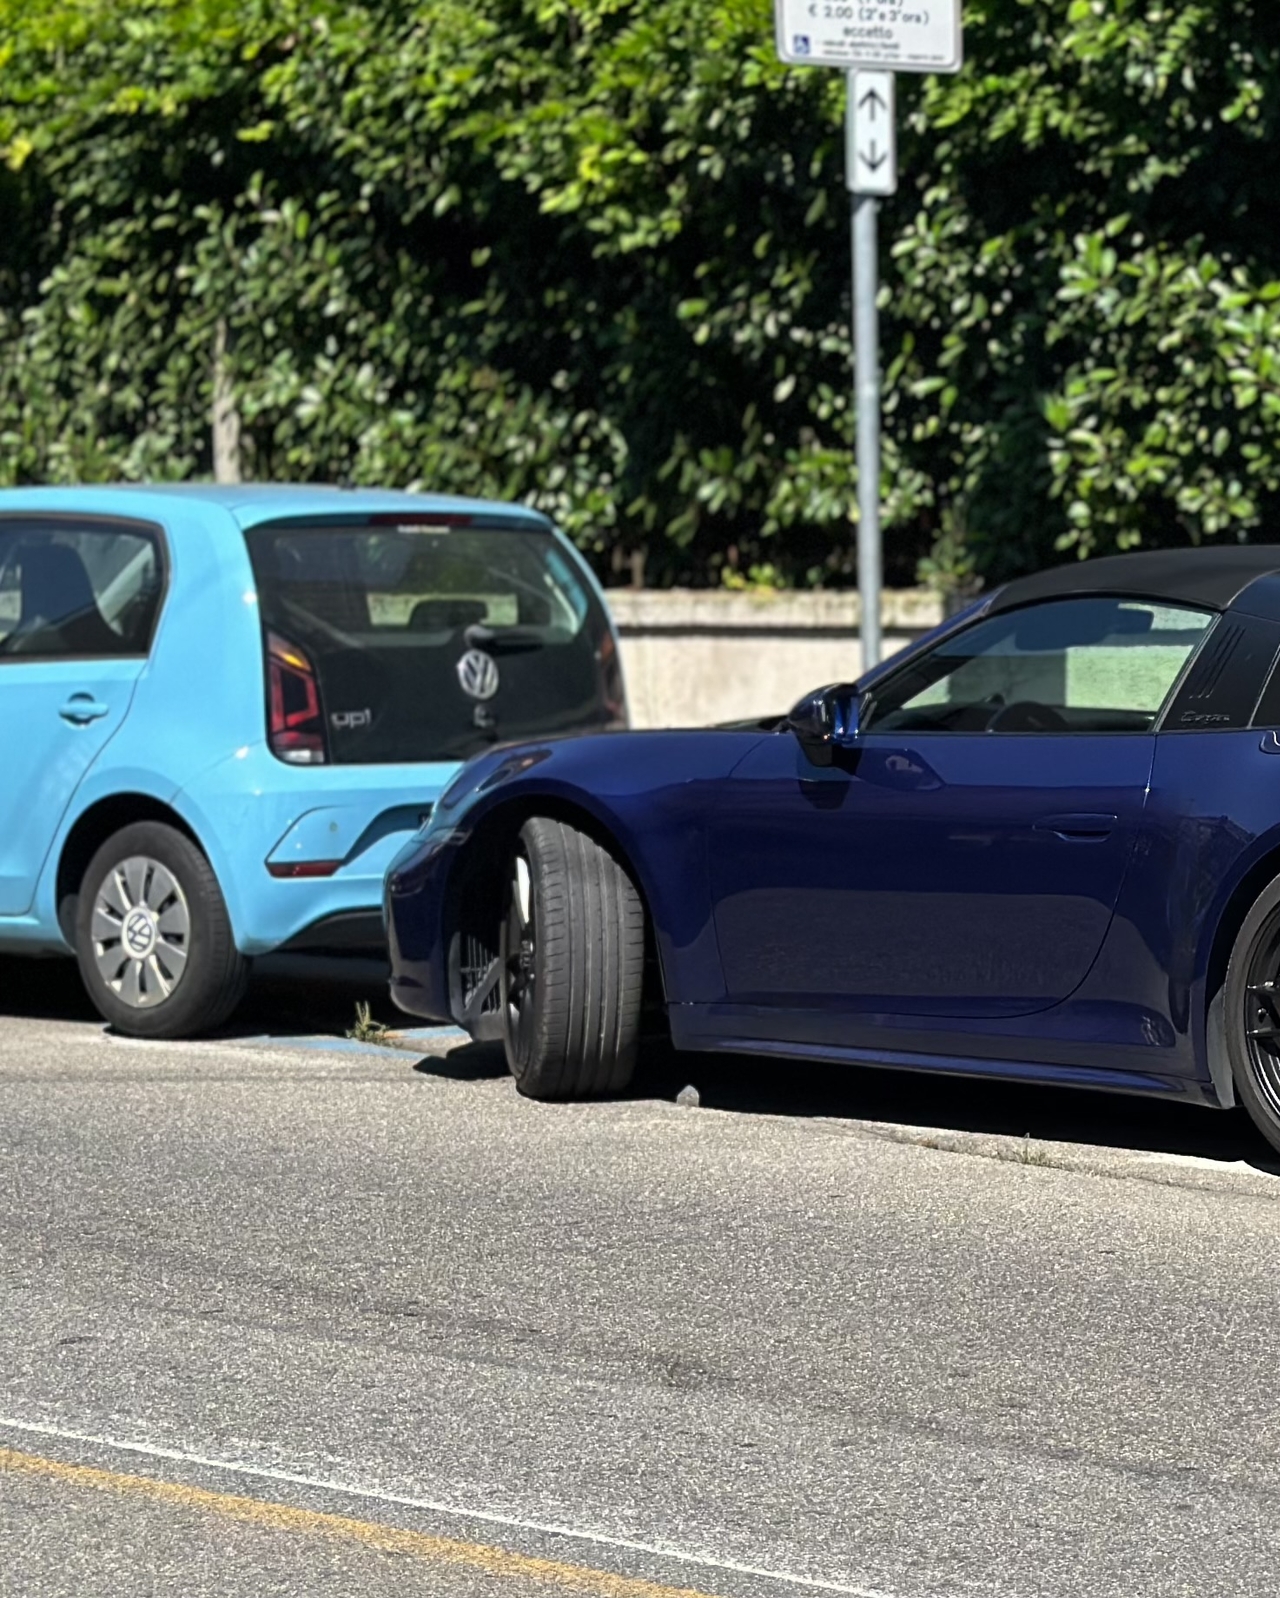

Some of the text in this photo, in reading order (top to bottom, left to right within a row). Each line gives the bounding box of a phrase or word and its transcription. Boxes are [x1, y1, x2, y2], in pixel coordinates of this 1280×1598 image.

[824, 5, 853, 19] 2.00
[842, 26, 893, 40] eccetto
[331, 707, 371, 728] up!
